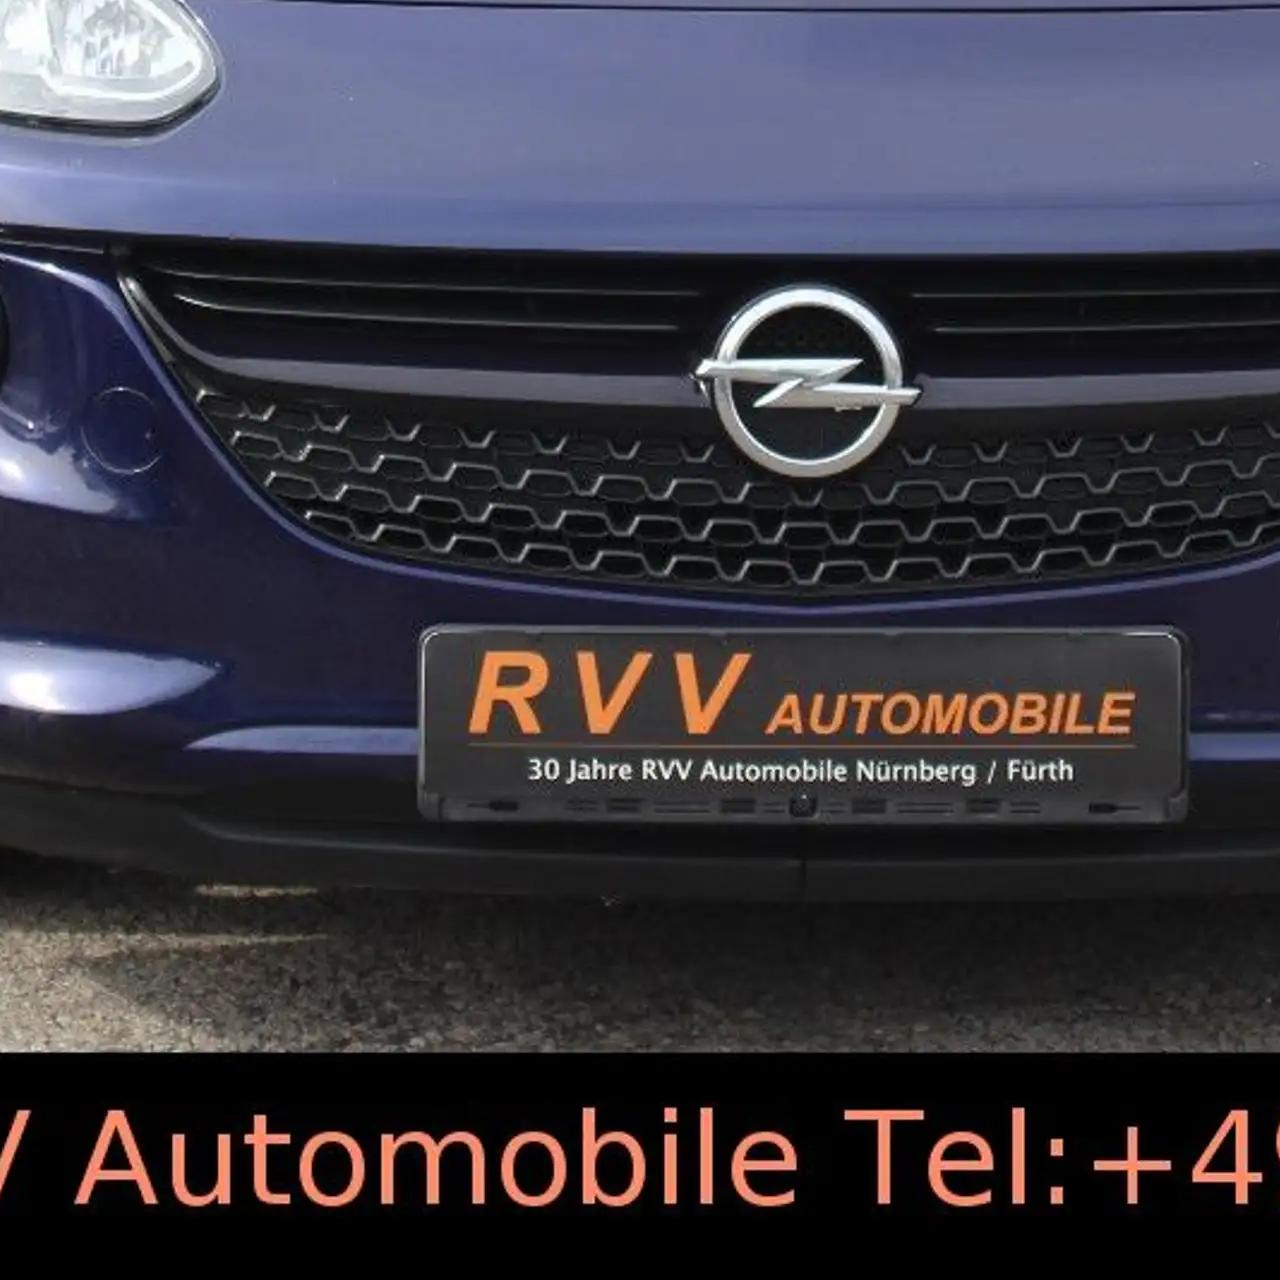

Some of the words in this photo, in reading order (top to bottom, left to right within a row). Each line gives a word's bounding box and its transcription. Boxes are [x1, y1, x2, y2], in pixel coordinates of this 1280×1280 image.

[764, 690, 1136, 735] AUTOMOBILE
[528, 757, 560, 781] 30
[565, 756, 633, 784] Jahre
[641, 757, 692, 781] RVV
[699, 756, 847, 782] Automobile
[856, 757, 976, 786] Nürnberg
[986, 759, 997, 784] /
[1007, 756, 1074, 782] Fürth
